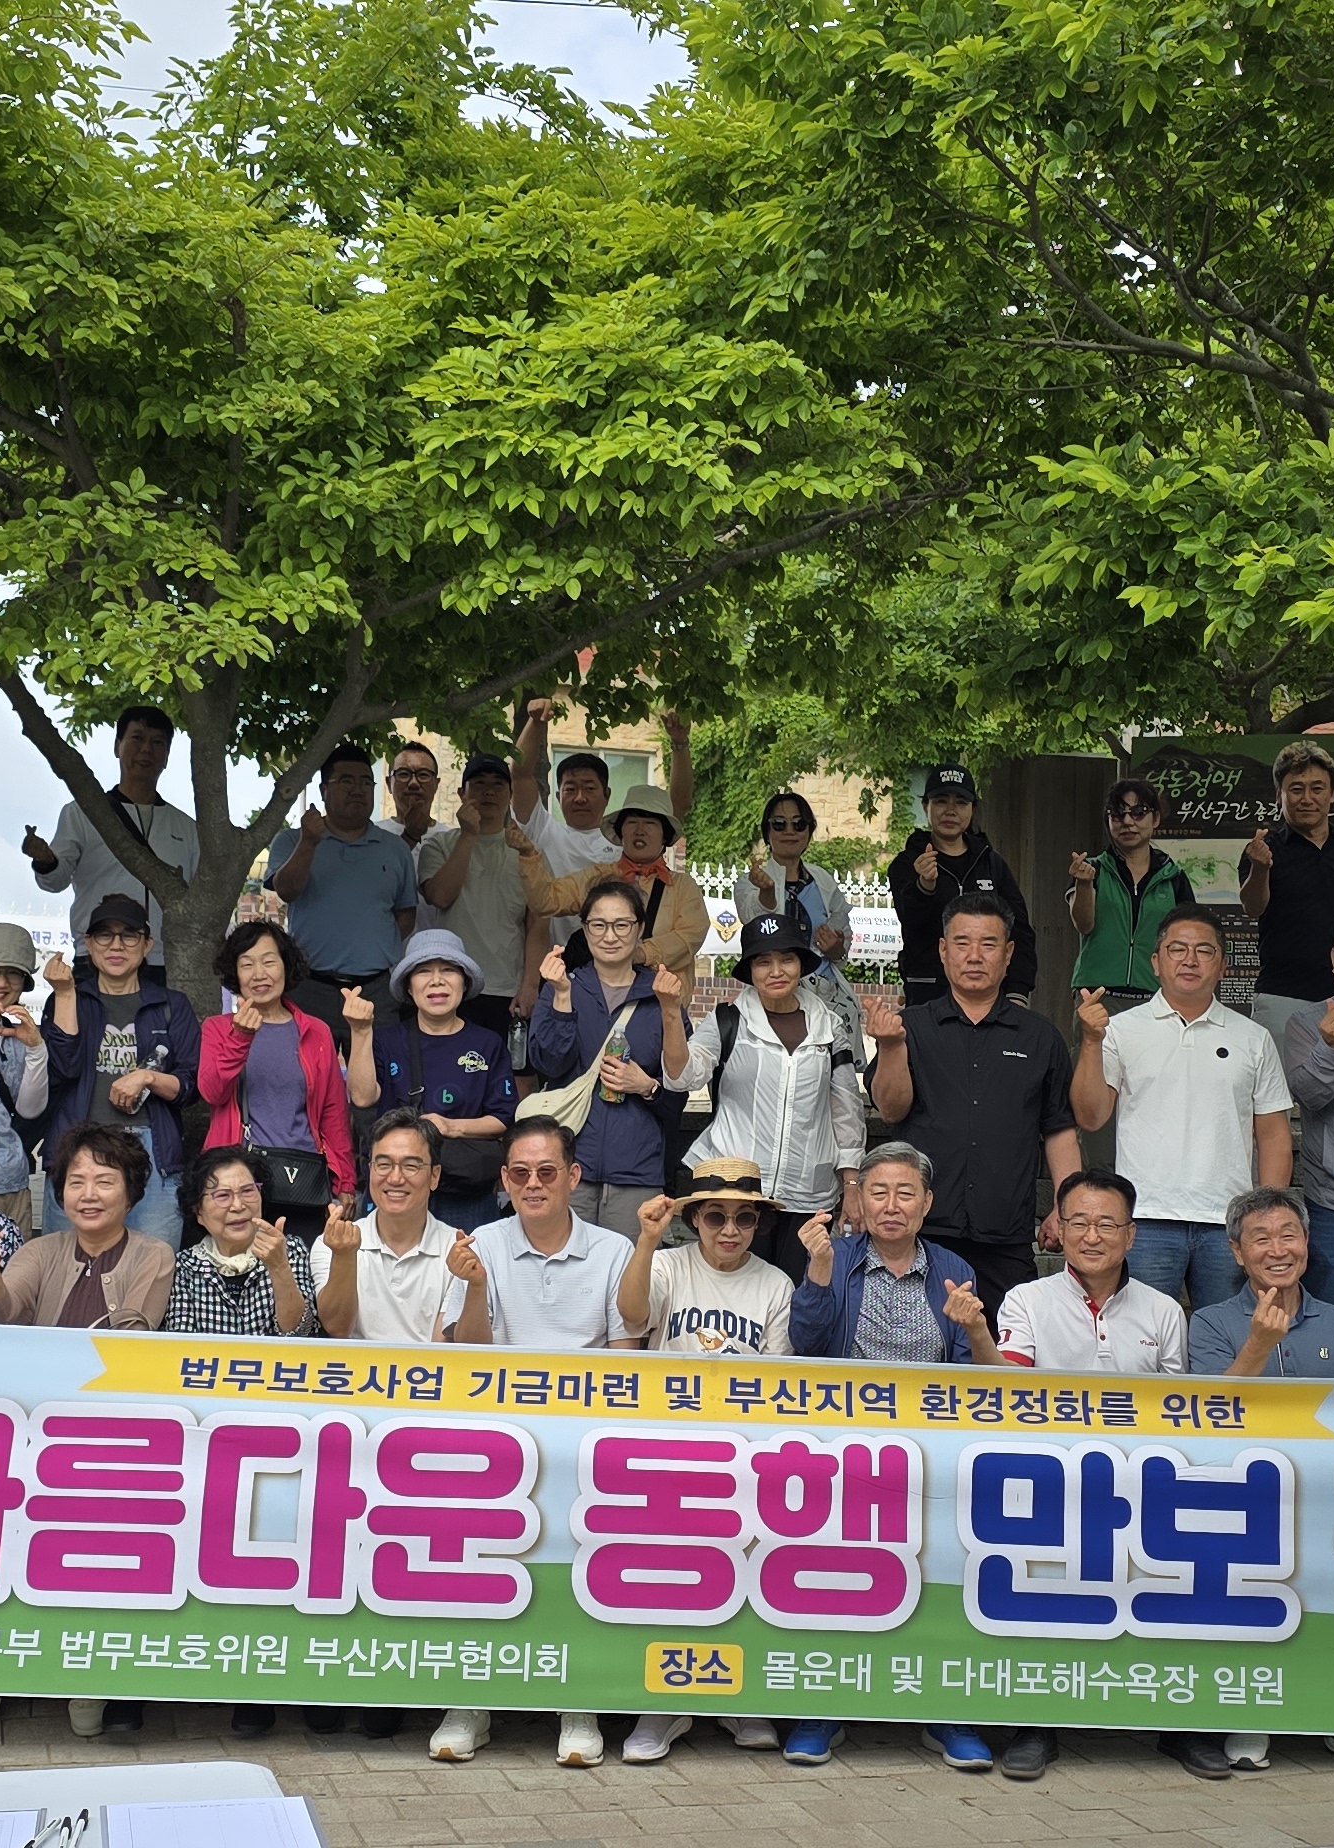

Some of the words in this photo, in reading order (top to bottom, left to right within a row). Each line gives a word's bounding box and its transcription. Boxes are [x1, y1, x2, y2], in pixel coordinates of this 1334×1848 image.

[1176, 800, 1252, 826] 부산구간
[442, 1089, 454, 1104] b
[283, 1165, 299, 1184] V
[667, 1306, 764, 1353] WOODIE
[179, 1356, 444, 1401] 법무보호사업
[470, 1369, 640, 1410] 기금마련
[663, 1372, 702, 1411] 및
[725, 1376, 898, 1420] 부산지역
[920, 1384, 1138, 1427] 환경정화를
[1161, 1394, 1245, 1430] 위한
[584, 1437, 909, 1617] 동행
[971, 1451, 1287, 1628] 만보
[59, 1628, 289, 1675] 법무보호위원
[302, 1636, 569, 1684] 부산지부협의회
[659, 1647, 734, 1687] 장소
[761, 1651, 872, 1693] 몰운대
[890, 1655, 923, 1695] 및
[941, 1656, 1200, 1704] 다대포해수욕장
[1213, 1666, 1284, 1706] 일원
